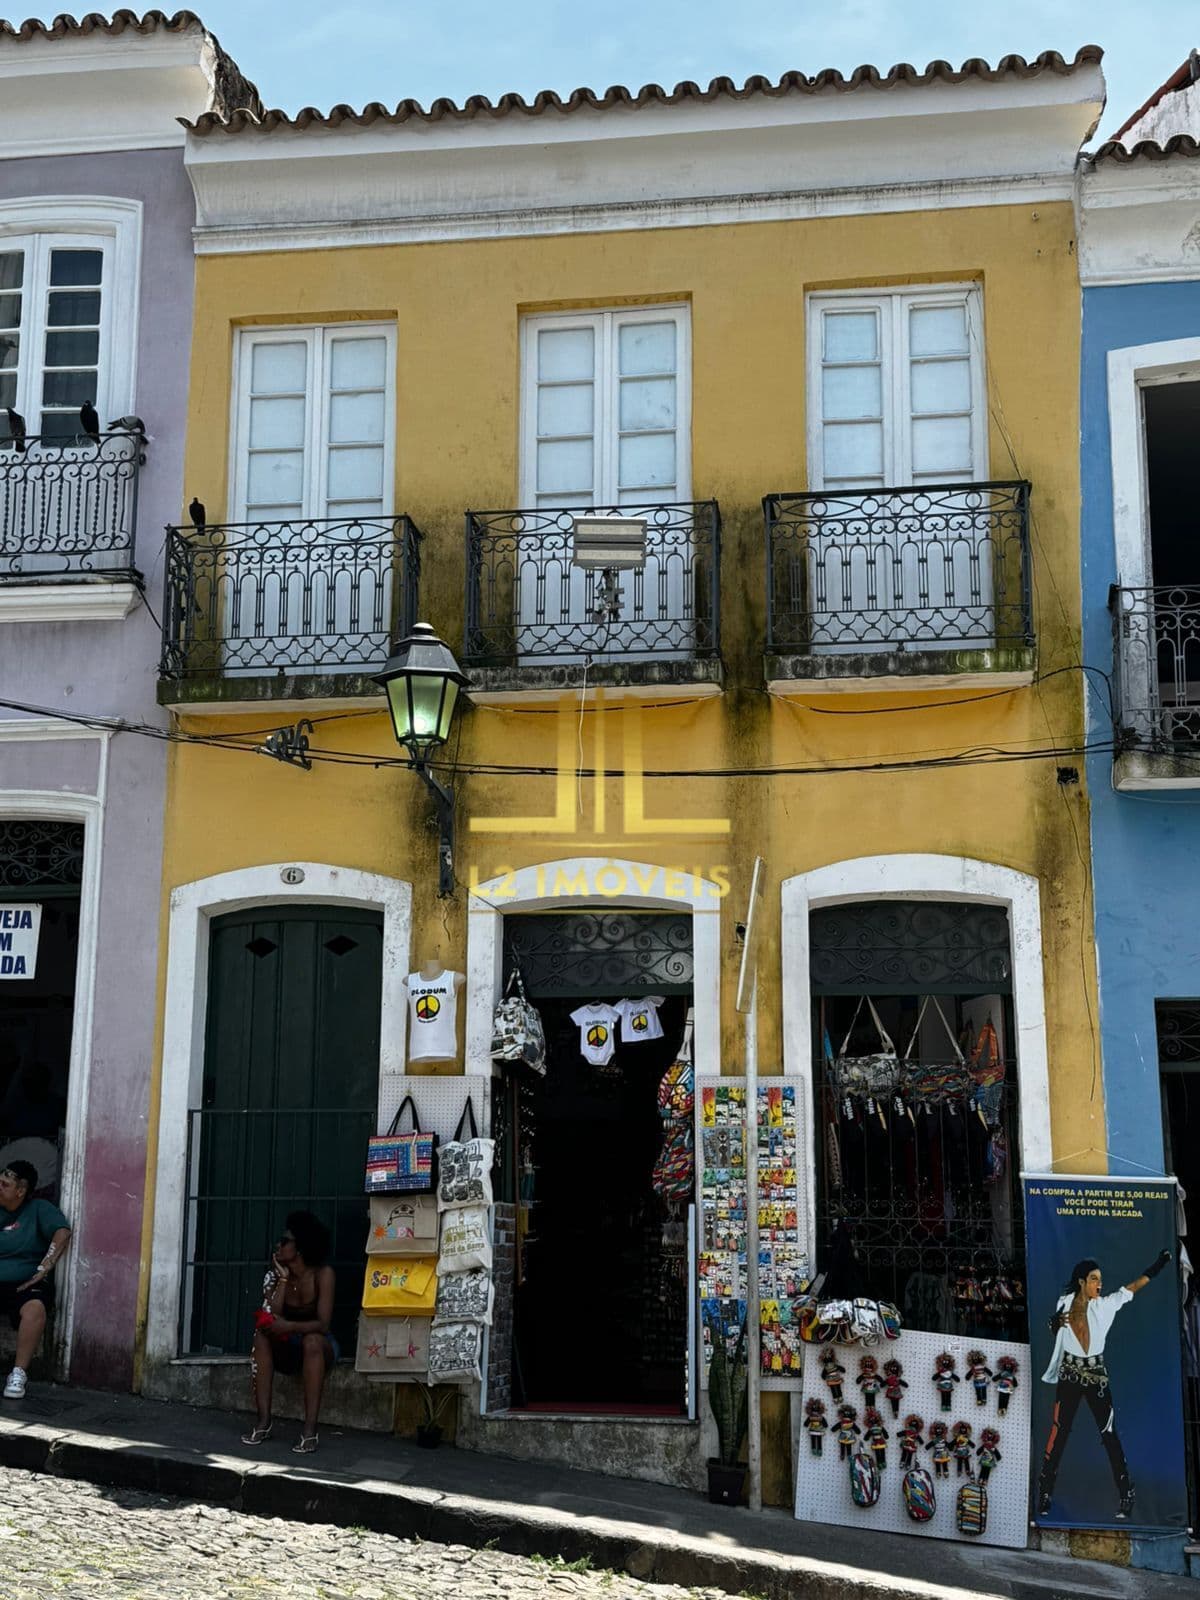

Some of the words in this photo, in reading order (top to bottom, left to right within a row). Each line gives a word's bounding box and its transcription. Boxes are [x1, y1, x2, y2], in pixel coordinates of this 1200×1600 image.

[286, 869, 297, 882] 6
[1029, 1187, 1041, 1196] NA
[1042, 1188, 1076, 1196] COMPRA
[1084, 1189, 1113, 1198] PARTIR
[1114, 1190, 1126, 1198] DE
[1126, 1191, 1144, 1199] 5,00
[1144, 1191, 1169, 1200] REAIS
[1064, 1198, 1085, 1206] VOCÊ
[1087, 1199, 1109, 1207] PODE
[1110, 1200, 1134, 1208] TIRAR
[1056, 1208, 1074, 1216] UMA
[1075, 1208, 1097, 1216] FOTO
[1098, 1209, 1110, 1217] NA
[1111, 1209, 1143, 1218] SACADA
